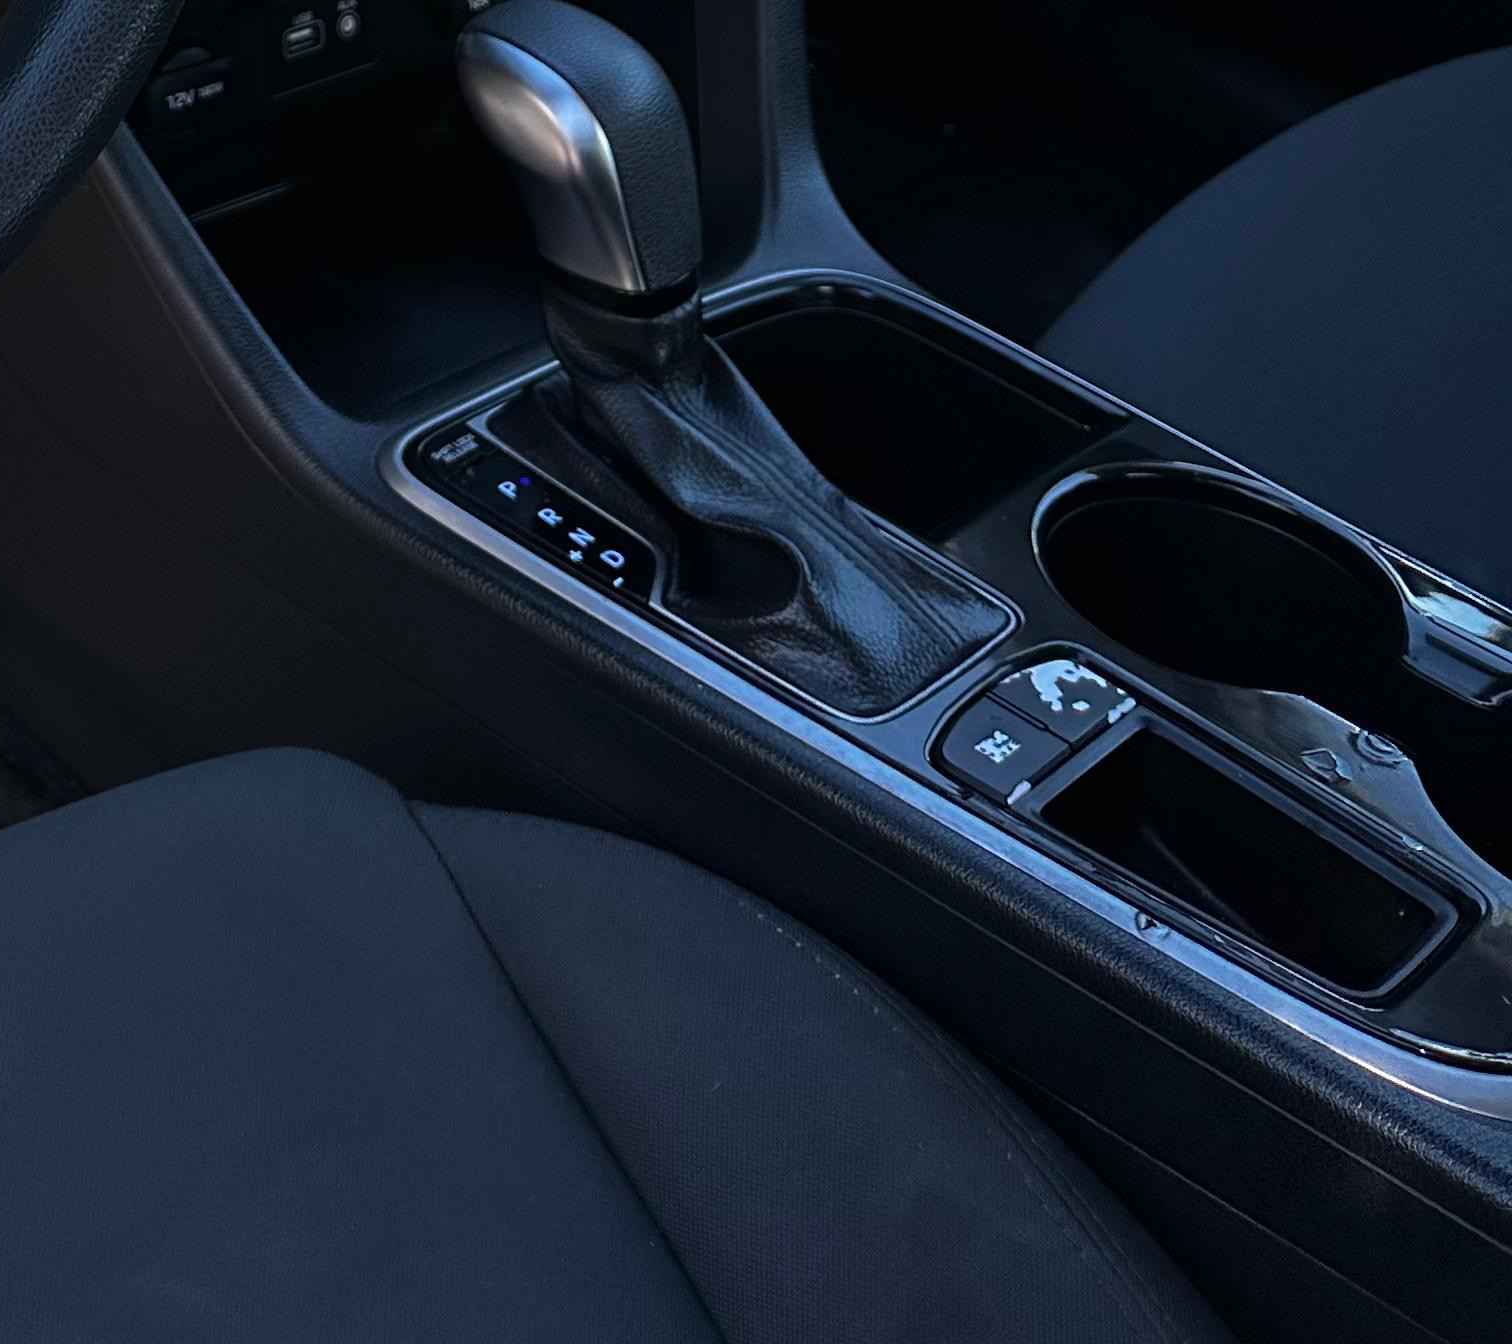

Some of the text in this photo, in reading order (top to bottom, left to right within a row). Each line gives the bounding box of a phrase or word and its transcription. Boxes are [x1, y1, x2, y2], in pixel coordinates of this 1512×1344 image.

[165, 87, 196, 112] 12V
[497, 480, 626, 570] P R N D
